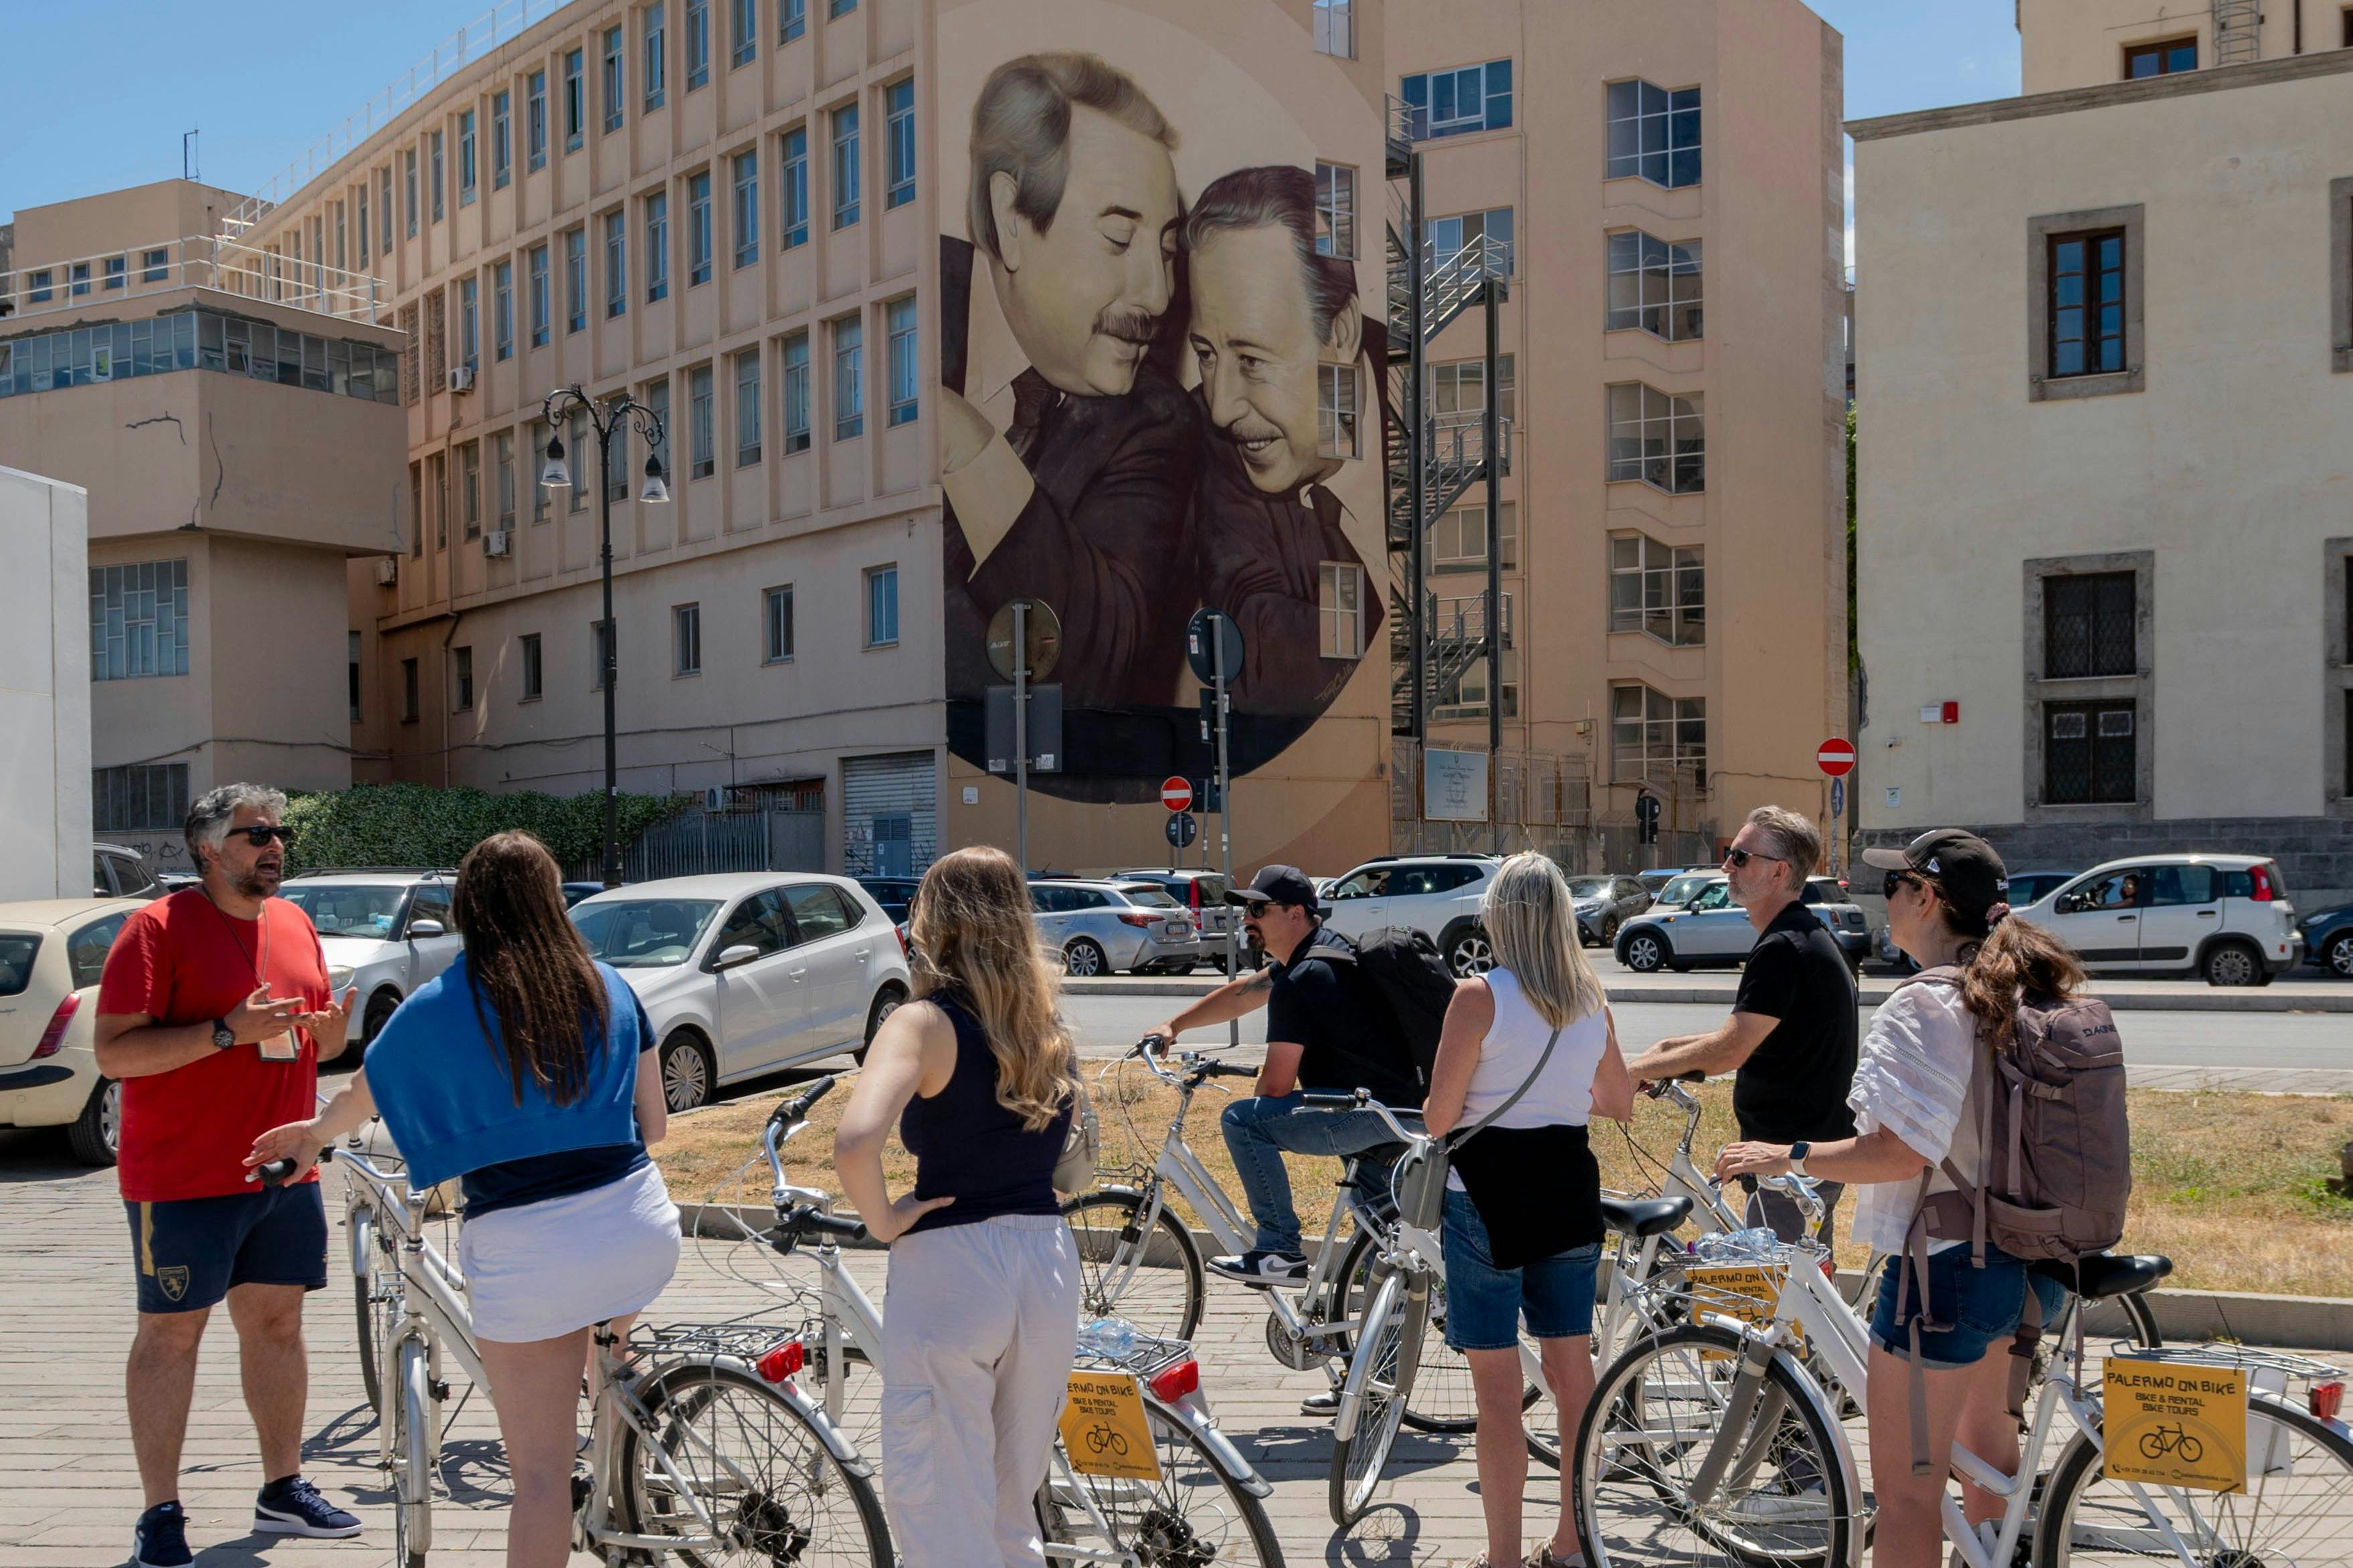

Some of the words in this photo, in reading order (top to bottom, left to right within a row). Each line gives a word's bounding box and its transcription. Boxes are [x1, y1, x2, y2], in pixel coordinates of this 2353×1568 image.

[1691, 1273, 1742, 1285] PALERMO
[1745, 1273, 1760, 1283] ON
[1067, 1382, 1094, 1393] ERMO
[1096, 1385, 1109, 1395] ON
[1110, 1385, 1134, 1397] BIKE
[2107, 1373, 2174, 1388] PALERMO
[2178, 1380, 2197, 1392] ON
[2201, 1381, 2235, 1395] BIKE
[1072, 1397, 1087, 1405] BIKE
[1094, 1399, 1118, 1407] RENTAL
[2135, 1392, 2157, 1402] BIKE
[2158, 1395, 2166, 1403] &
[2168, 1395, 2205, 1407] RENTAL
[1079, 1405, 1094, 1413] BIKE
[1095, 1407, 1116, 1416] TOURS
[2142, 1403, 2164, 1413] BIKE
[2167, 1405, 2198, 1416] TOURS
